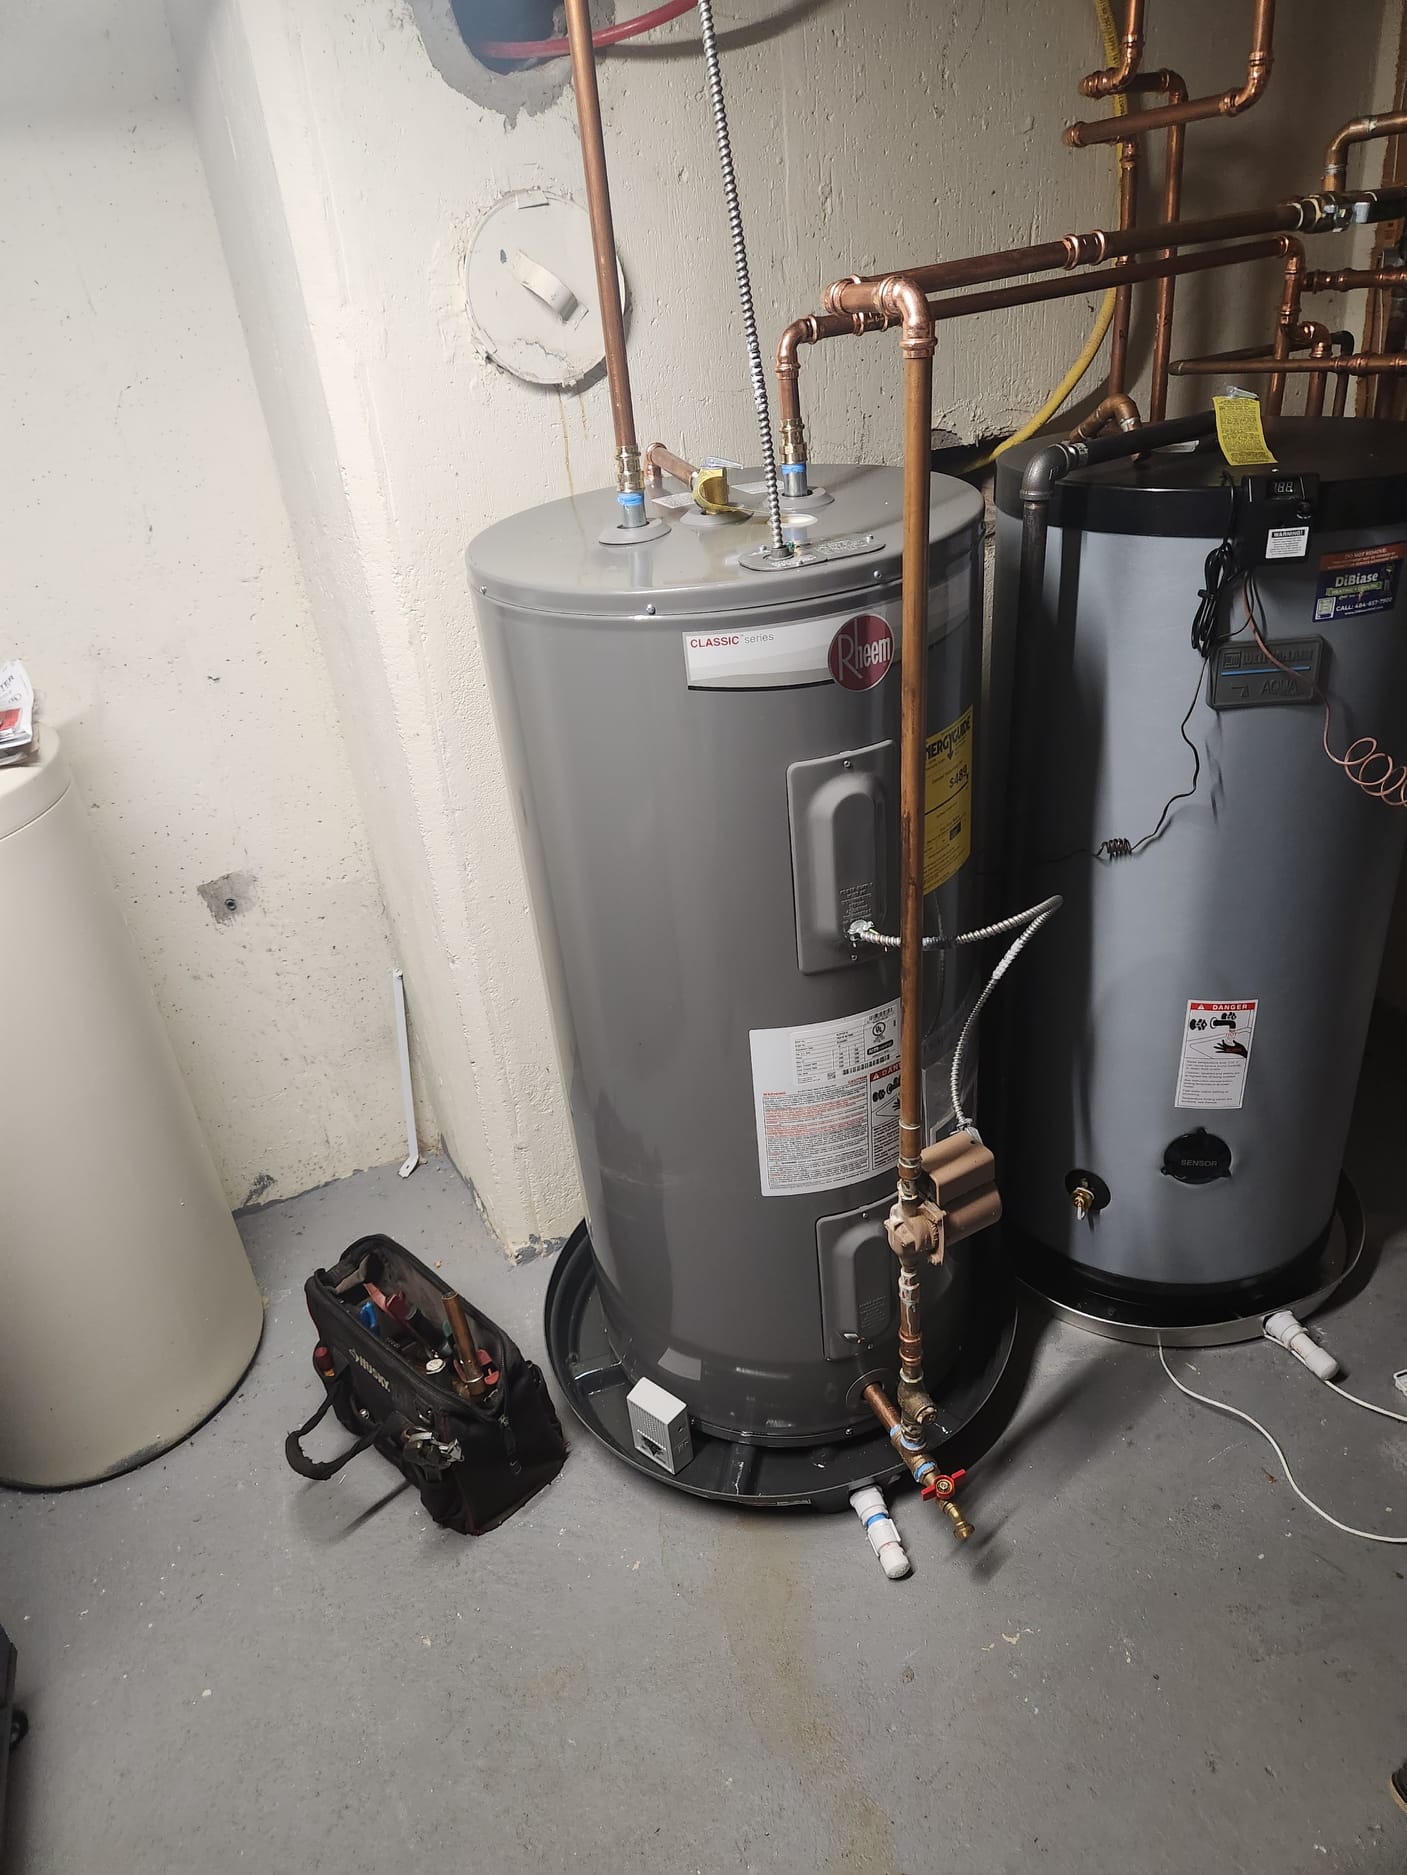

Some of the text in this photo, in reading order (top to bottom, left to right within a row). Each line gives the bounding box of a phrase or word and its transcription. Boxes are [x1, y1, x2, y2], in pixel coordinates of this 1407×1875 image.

[1335, 573, 1379, 587] DiBiase
[690, 633, 775, 648] CLASSIC series
[837, 617, 891, 682] Rheem
[1181, 1159, 1218, 1168] SENSOR
